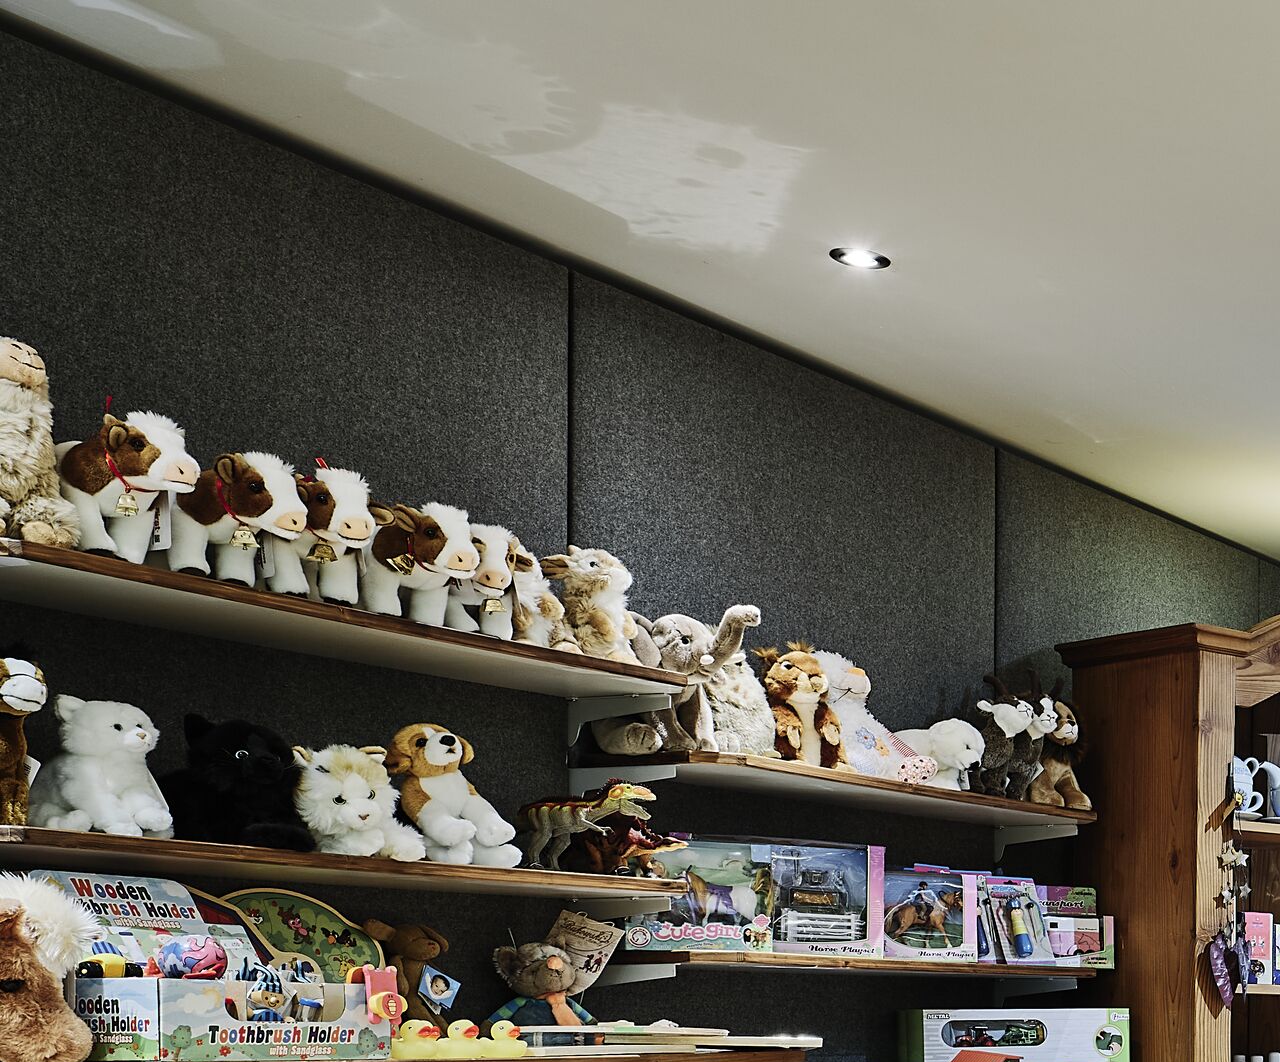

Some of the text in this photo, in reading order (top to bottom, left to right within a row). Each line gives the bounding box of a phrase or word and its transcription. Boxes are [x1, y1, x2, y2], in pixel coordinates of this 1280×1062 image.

[70, 878, 151, 900] Wooden
[148, 901, 196, 920] Holder
[113, 918, 182, 929] with Sandglass
[652, 923, 742, 940] Cute girl
[76, 995, 120, 1014] ooden
[111, 1016, 150, 1032] Holder
[100, 1034, 133, 1043] Sandglass
[208, 1026, 355, 1044] Toothbrush Holder
[269, 1045, 332, 1056] with Sandglass
